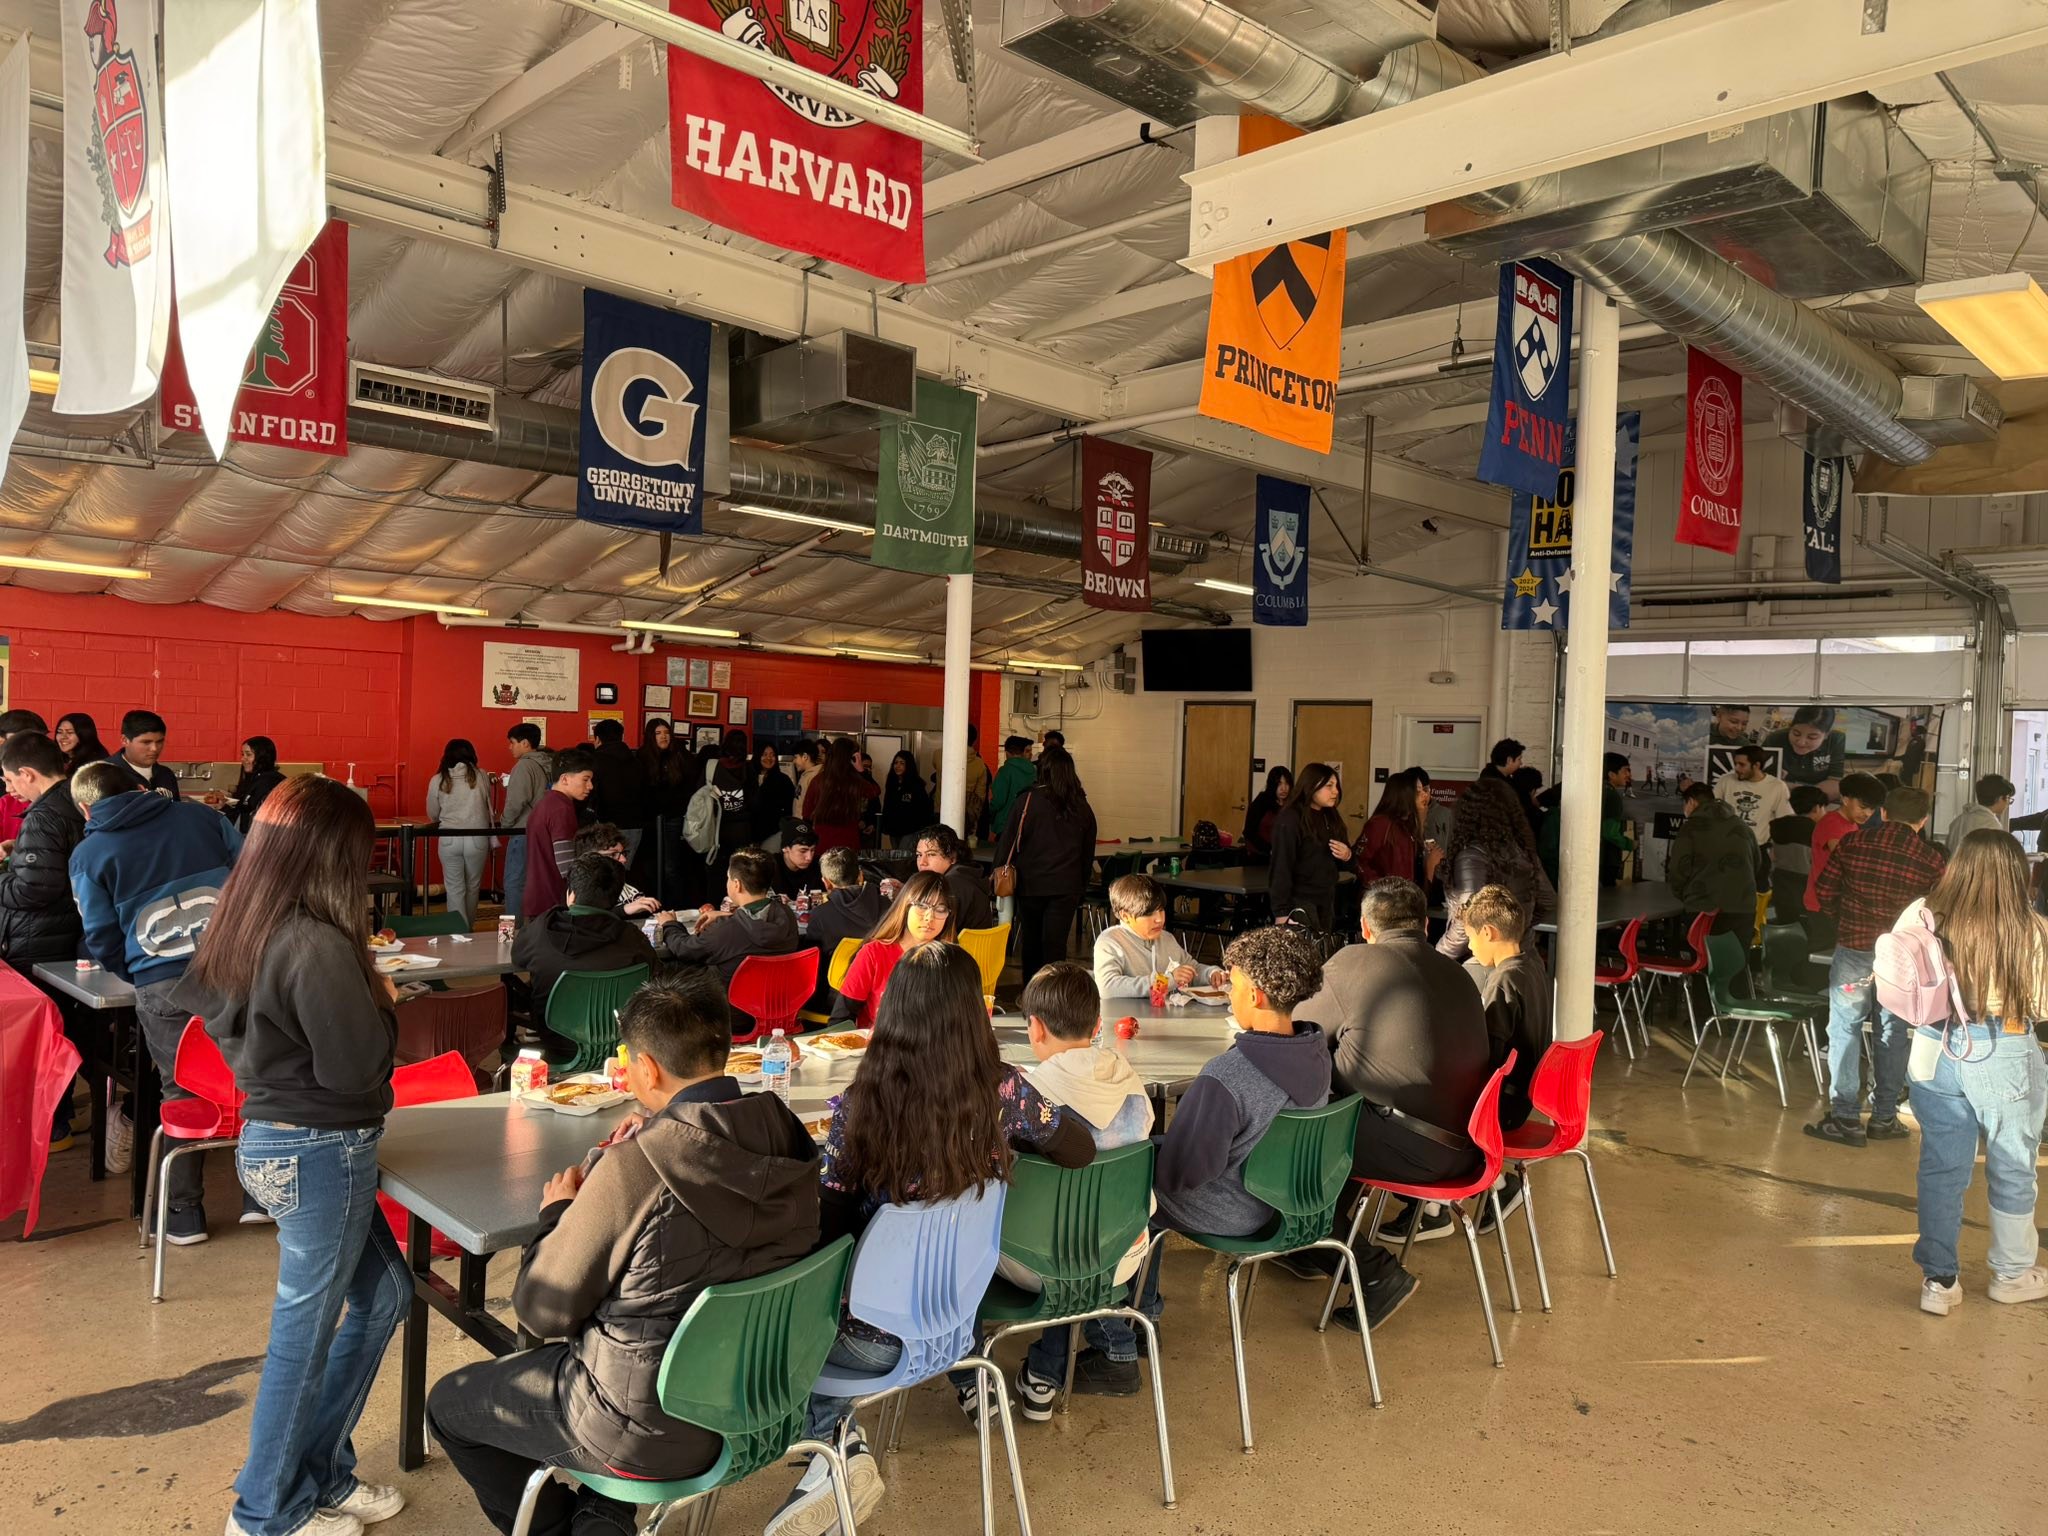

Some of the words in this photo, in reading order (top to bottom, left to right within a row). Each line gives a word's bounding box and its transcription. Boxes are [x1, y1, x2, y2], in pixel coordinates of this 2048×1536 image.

[791, 0, 828, 32] TAS
[686, 113, 912, 231] HARVARD
[1215, 344, 1337, 415] PRINCETON
[174, 404, 336, 445] SNFORD
[591, 347, 700, 471] G
[1501, 400, 1564, 466] PENN
[587, 467, 695, 499] GEORGETOWN
[592, 484, 691, 515] UNIVERSITY
[913, 503, 940, 516] 1769
[1690, 494, 1740, 527] CORNELL
[882, 523, 968, 547] DARTMOUTH
[1533, 509, 1572, 544] HA
[1530, 549, 1571, 557] Anti-Defama
[1084, 569, 1146, 598] BROWN
[1255, 593, 1306, 609] COLUMBIA
